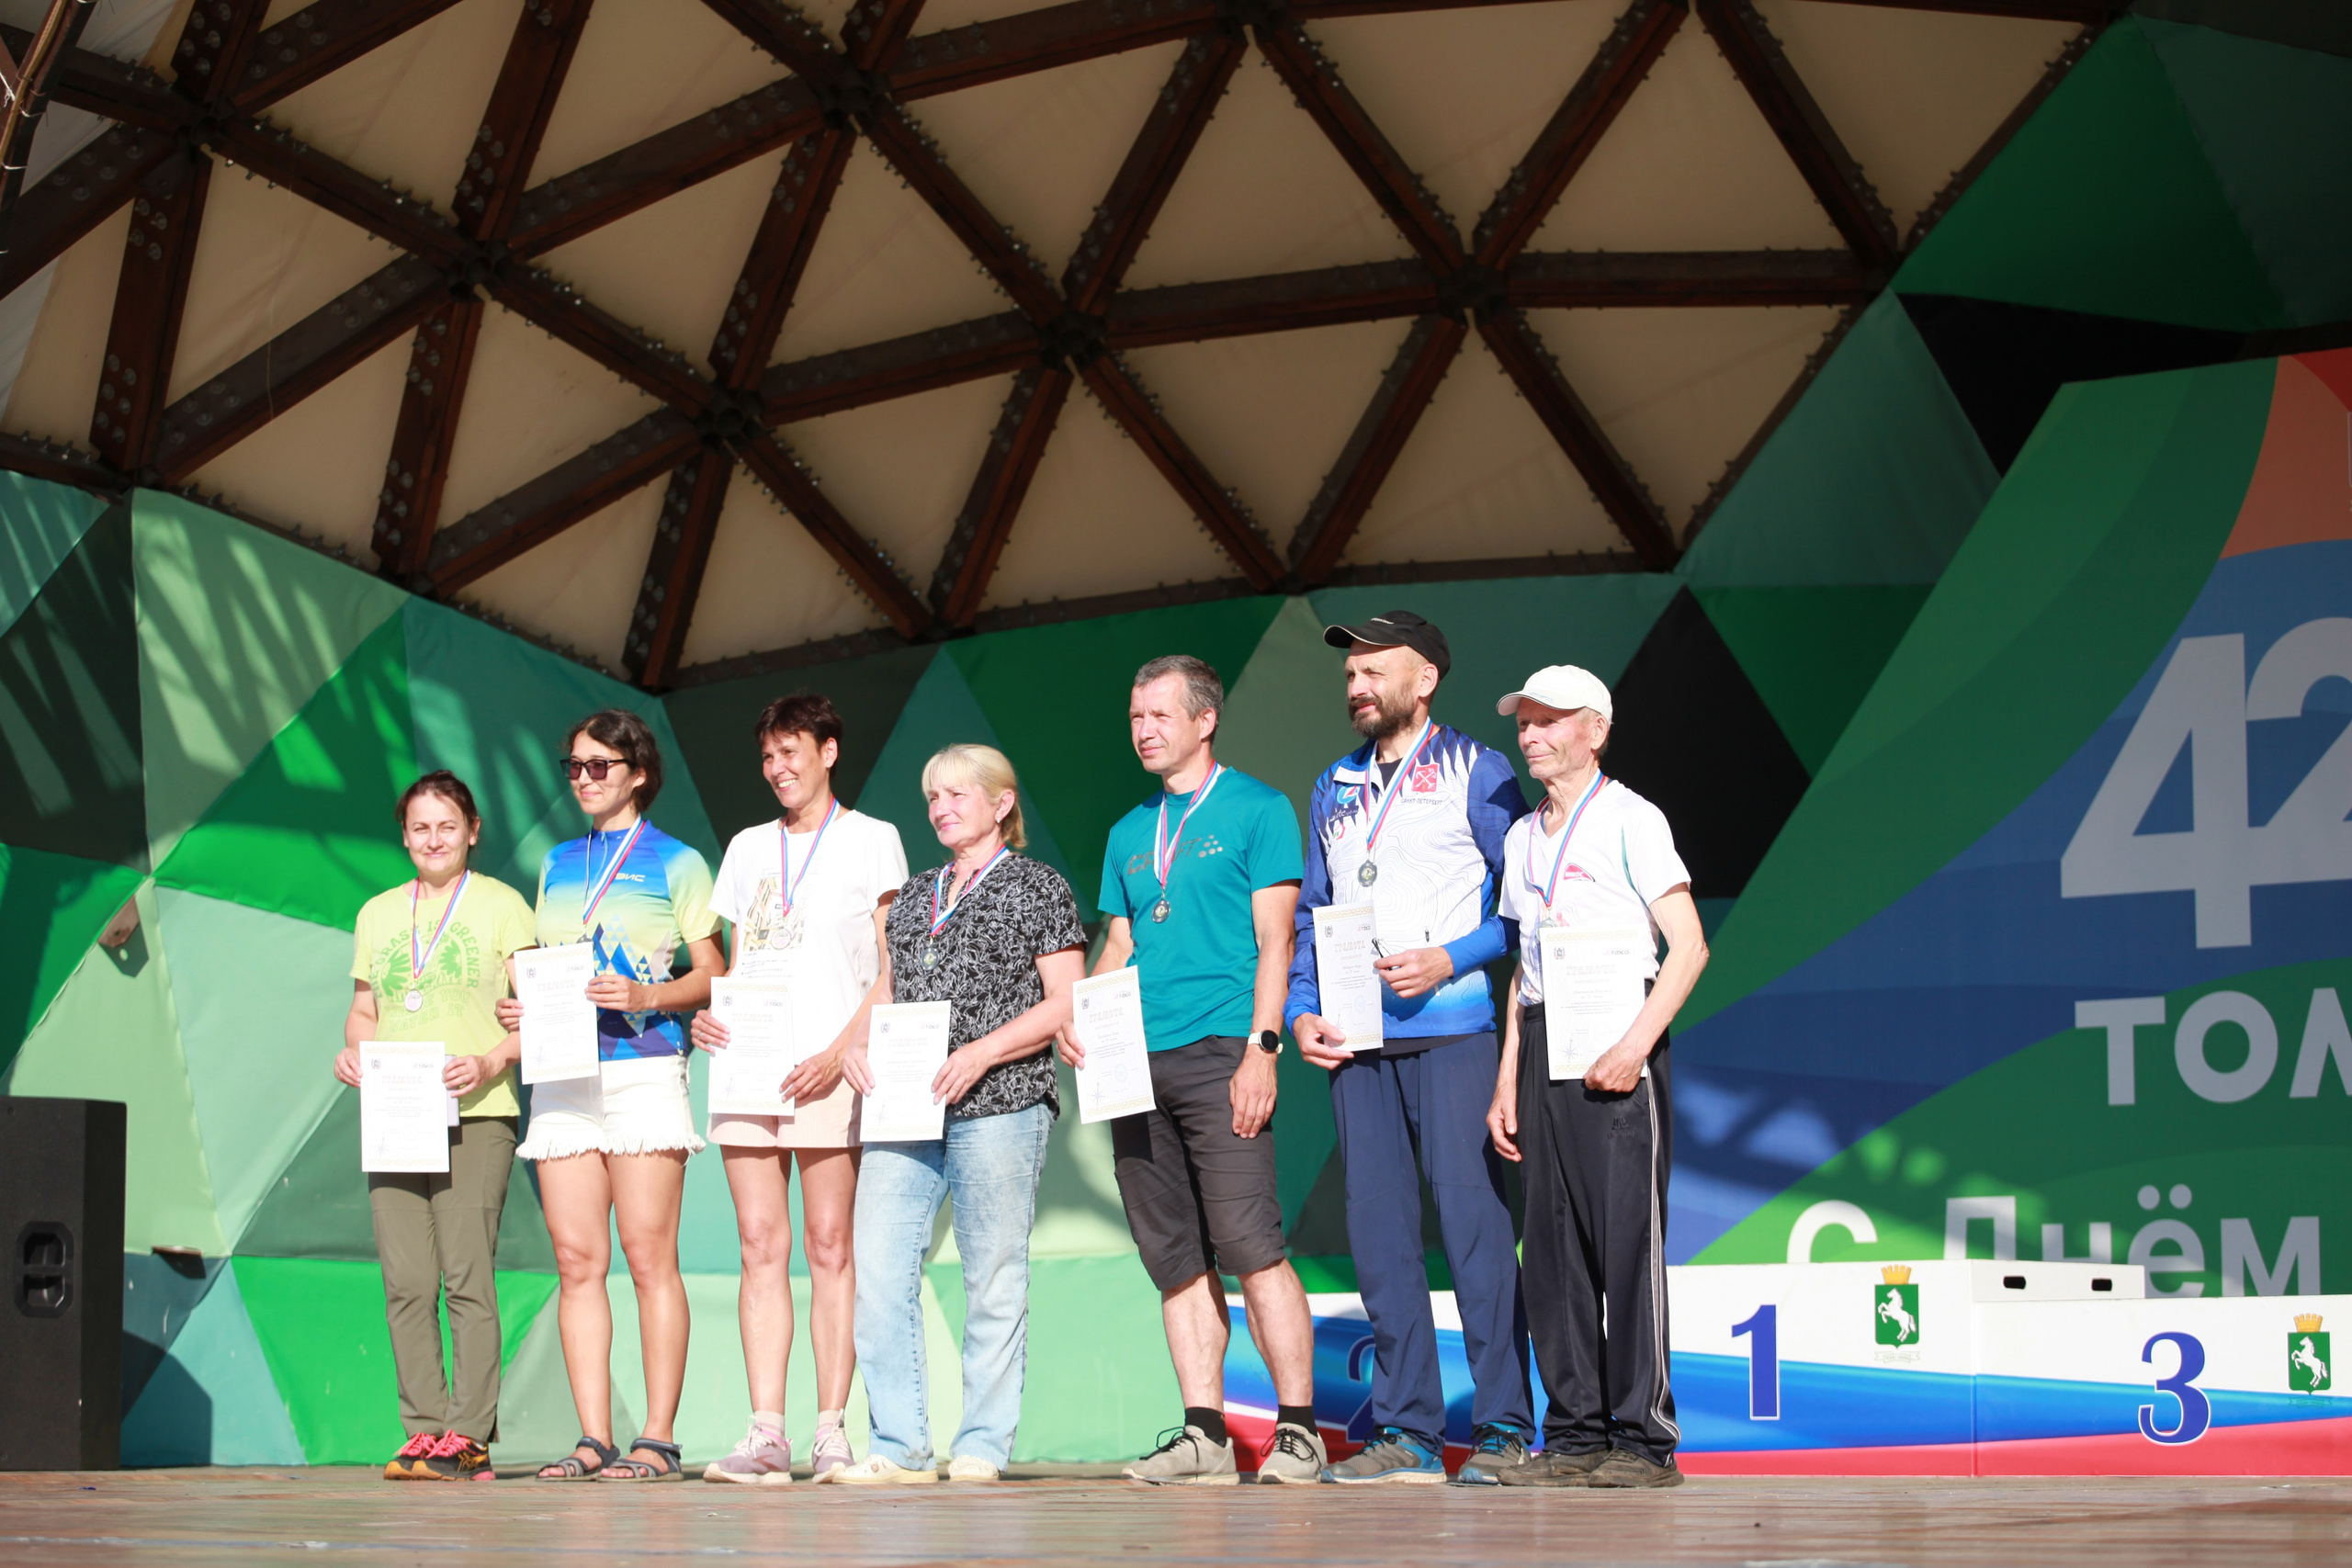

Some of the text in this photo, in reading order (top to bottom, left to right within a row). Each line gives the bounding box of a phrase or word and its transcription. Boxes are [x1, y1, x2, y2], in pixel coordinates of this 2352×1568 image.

[1127, 837, 1202, 875] CRFT
[449, 921, 481, 988] GREENER
[1731, 1303, 1781, 1421] 1
[2137, 1331, 2212, 1446] 3
